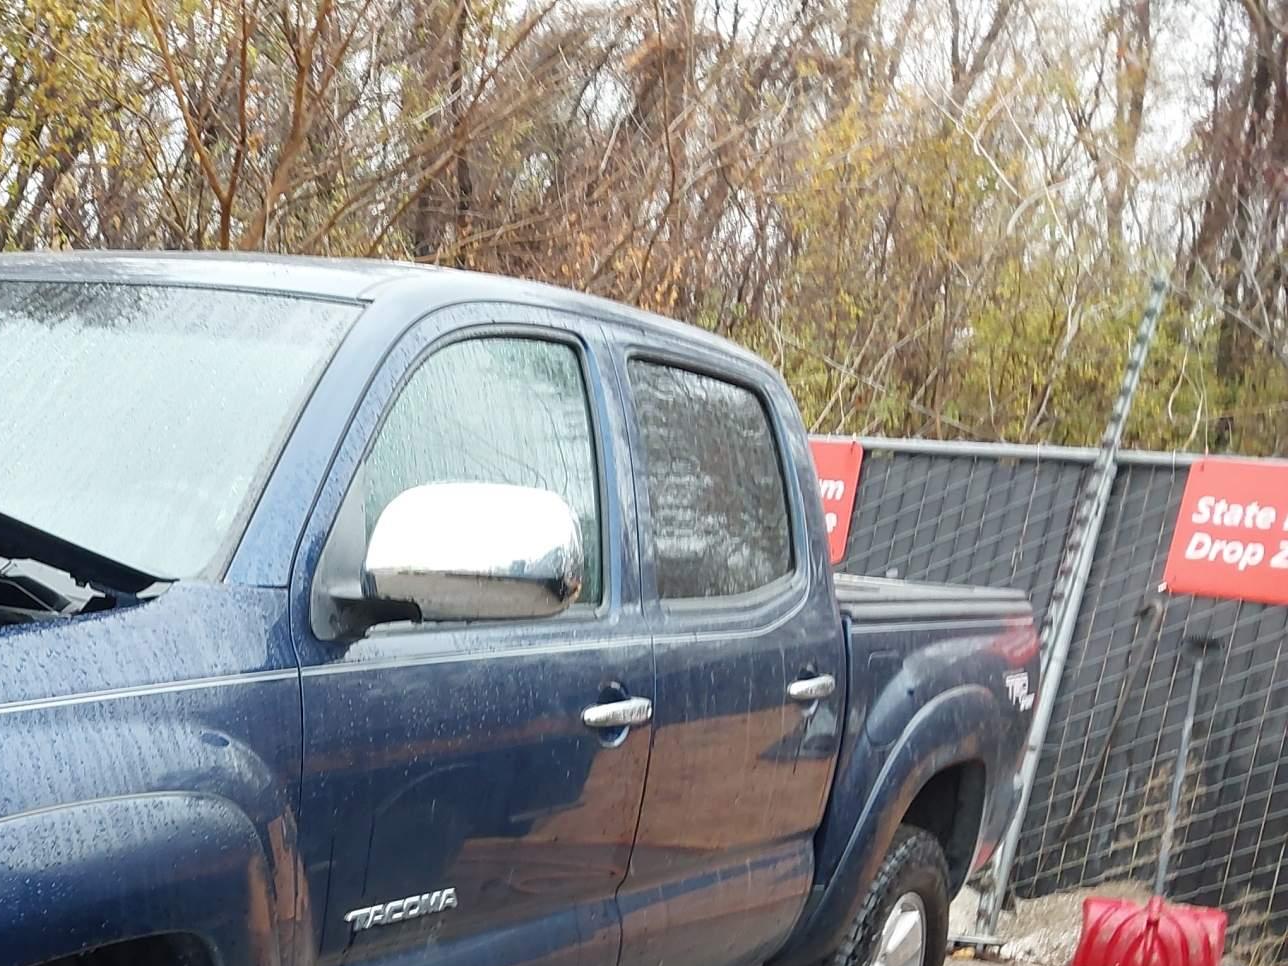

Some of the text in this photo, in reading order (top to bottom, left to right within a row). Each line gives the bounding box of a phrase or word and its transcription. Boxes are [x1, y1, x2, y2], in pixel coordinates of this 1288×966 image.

[1191, 495, 1277, 530] State
[1184, 531, 1265, 572] Drop
[343, 887, 459, 932] TACOMA
